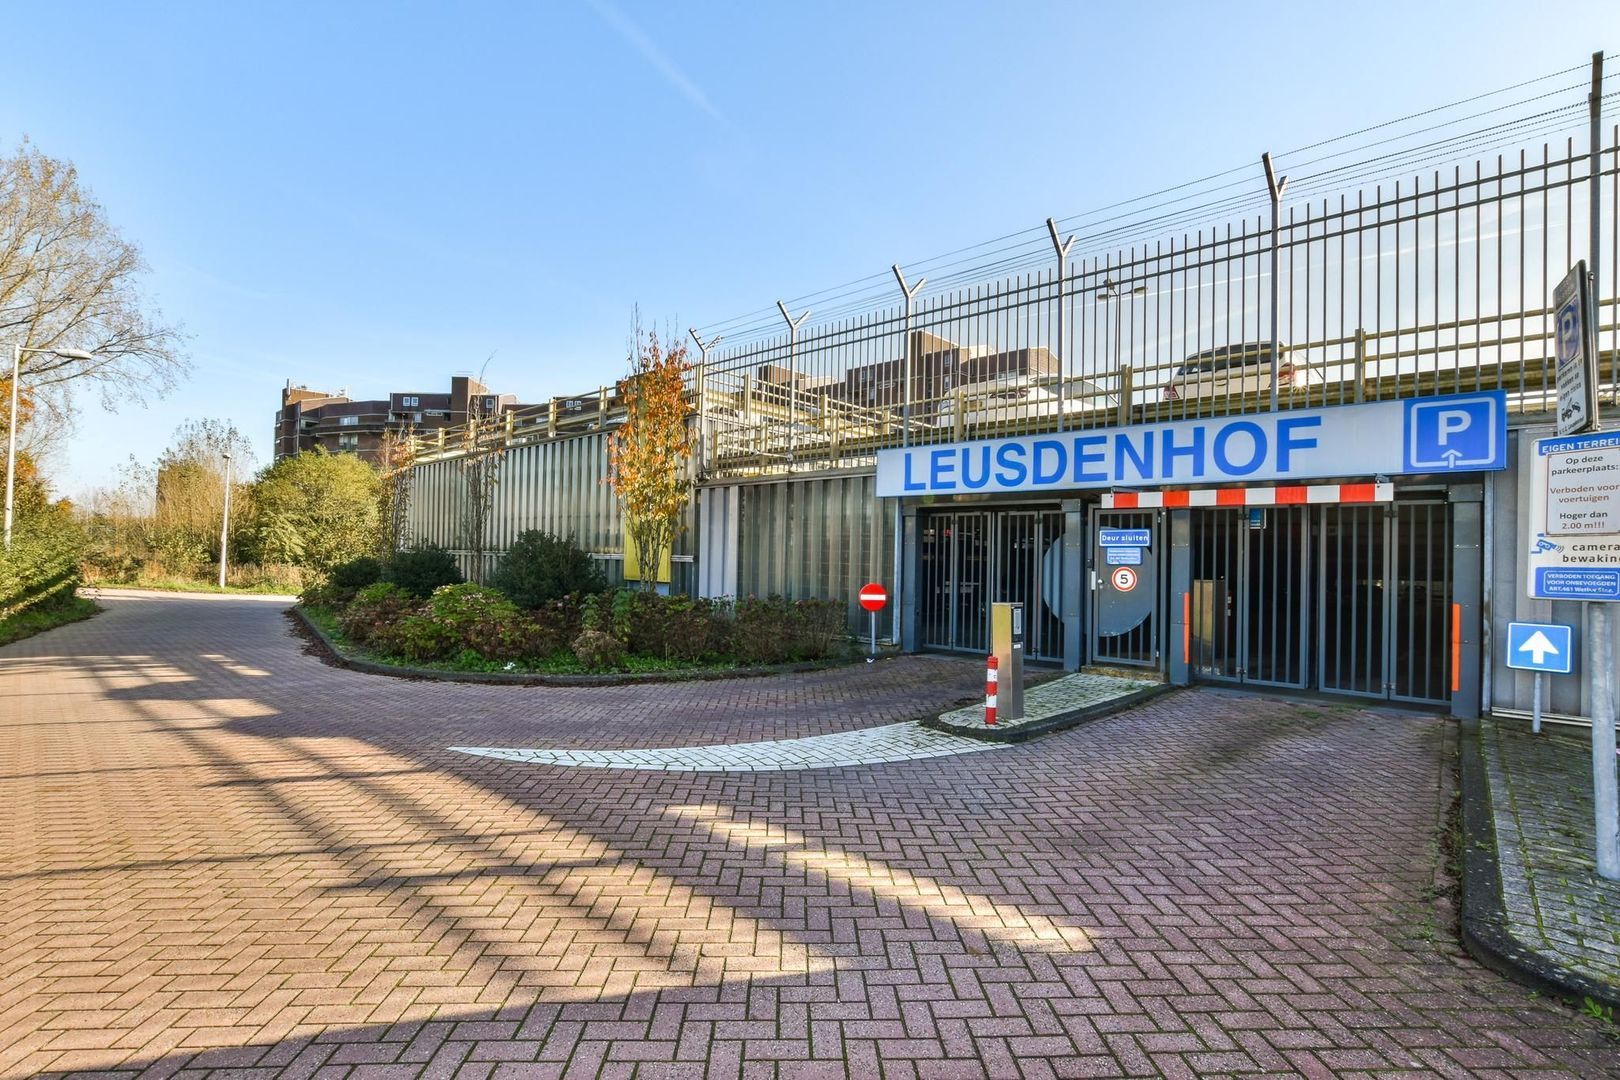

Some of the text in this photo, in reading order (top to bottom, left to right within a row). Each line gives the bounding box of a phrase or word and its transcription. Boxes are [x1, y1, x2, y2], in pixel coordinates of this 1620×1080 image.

[1438, 410, 1471, 446] P
[903, 415, 1322, 491] LEUSDENHOF
[1542, 443, 1575, 453] EIGEN
[1565, 455, 1604, 465] Op deze
[1551, 464, 1619, 476] parkeerplaats:
[1550, 485, 1595, 494] Verboden
[1558, 494, 1610, 503] voertuigen
[1559, 512, 1587, 520] Hoger
[1562, 521, 1605, 530] 2.00 m!!!
[1562, 554, 1620, 563] bewakin
[1120, 574, 1129, 584] 5
